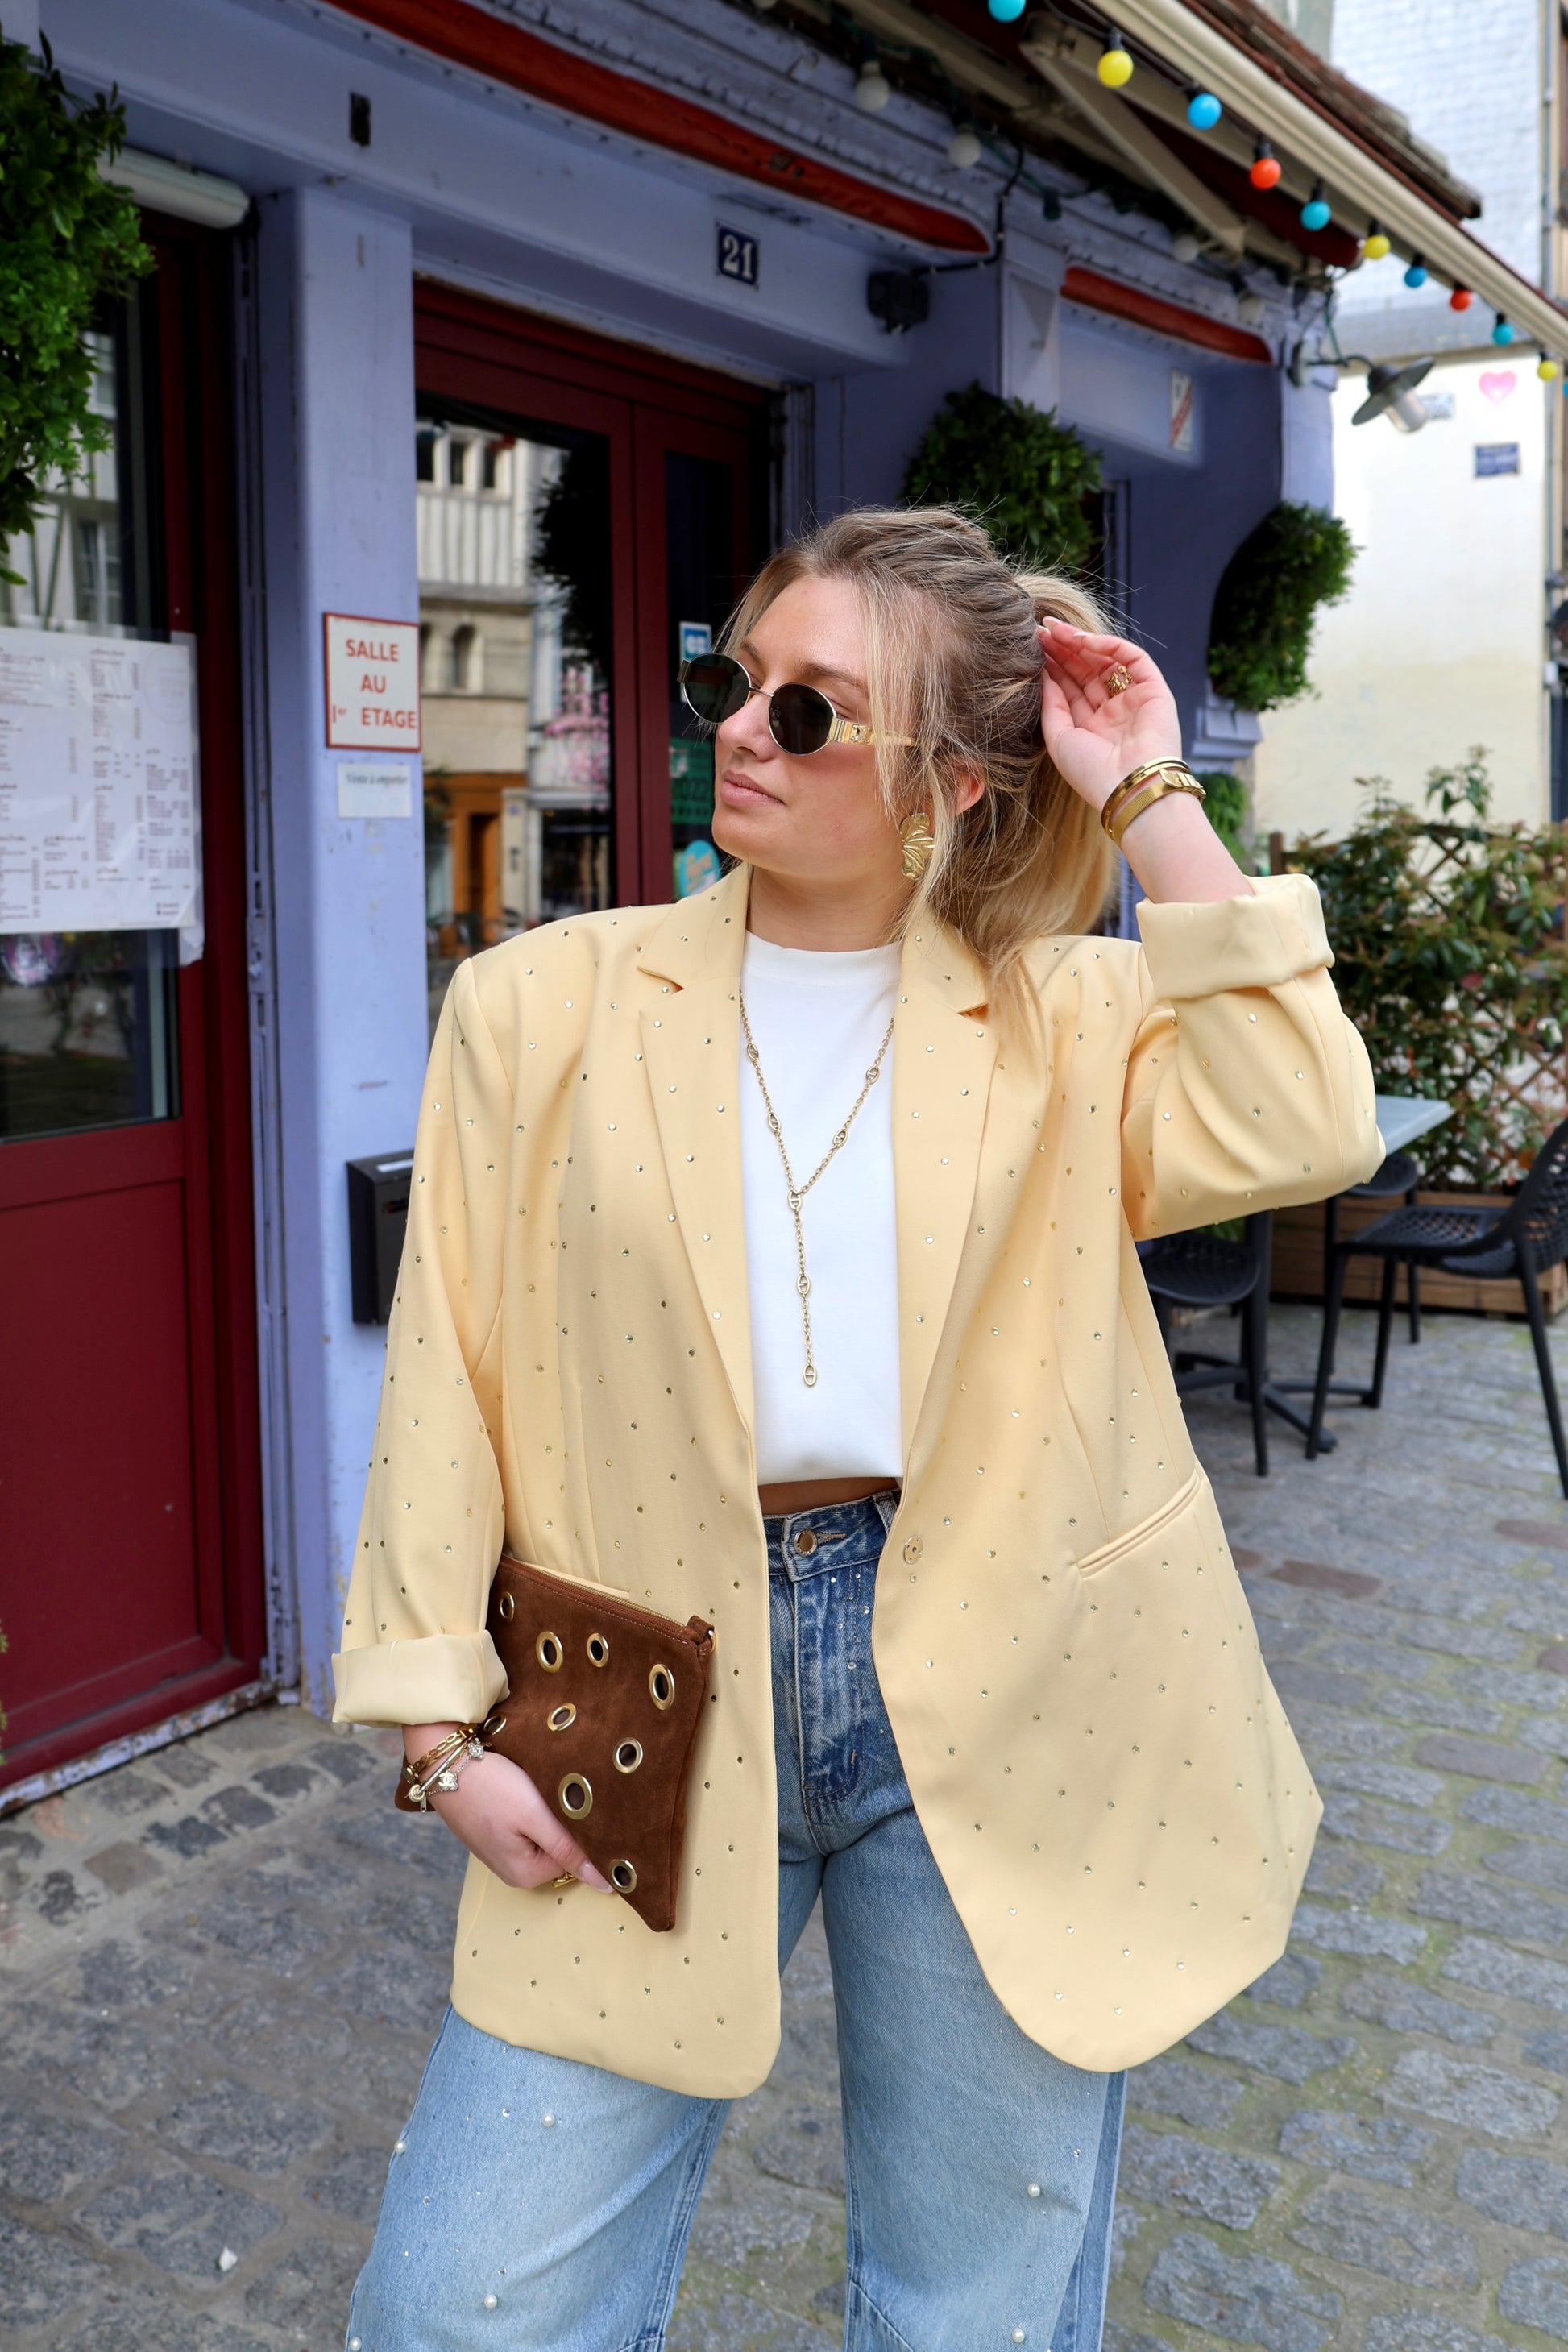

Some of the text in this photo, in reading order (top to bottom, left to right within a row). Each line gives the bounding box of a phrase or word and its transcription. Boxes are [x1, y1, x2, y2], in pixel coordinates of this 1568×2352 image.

[723, 234, 753, 279] 21
[346, 638, 400, 663] SALLE
[360, 674, 387, 695] AU
[362, 707, 417, 729] ETAGE
